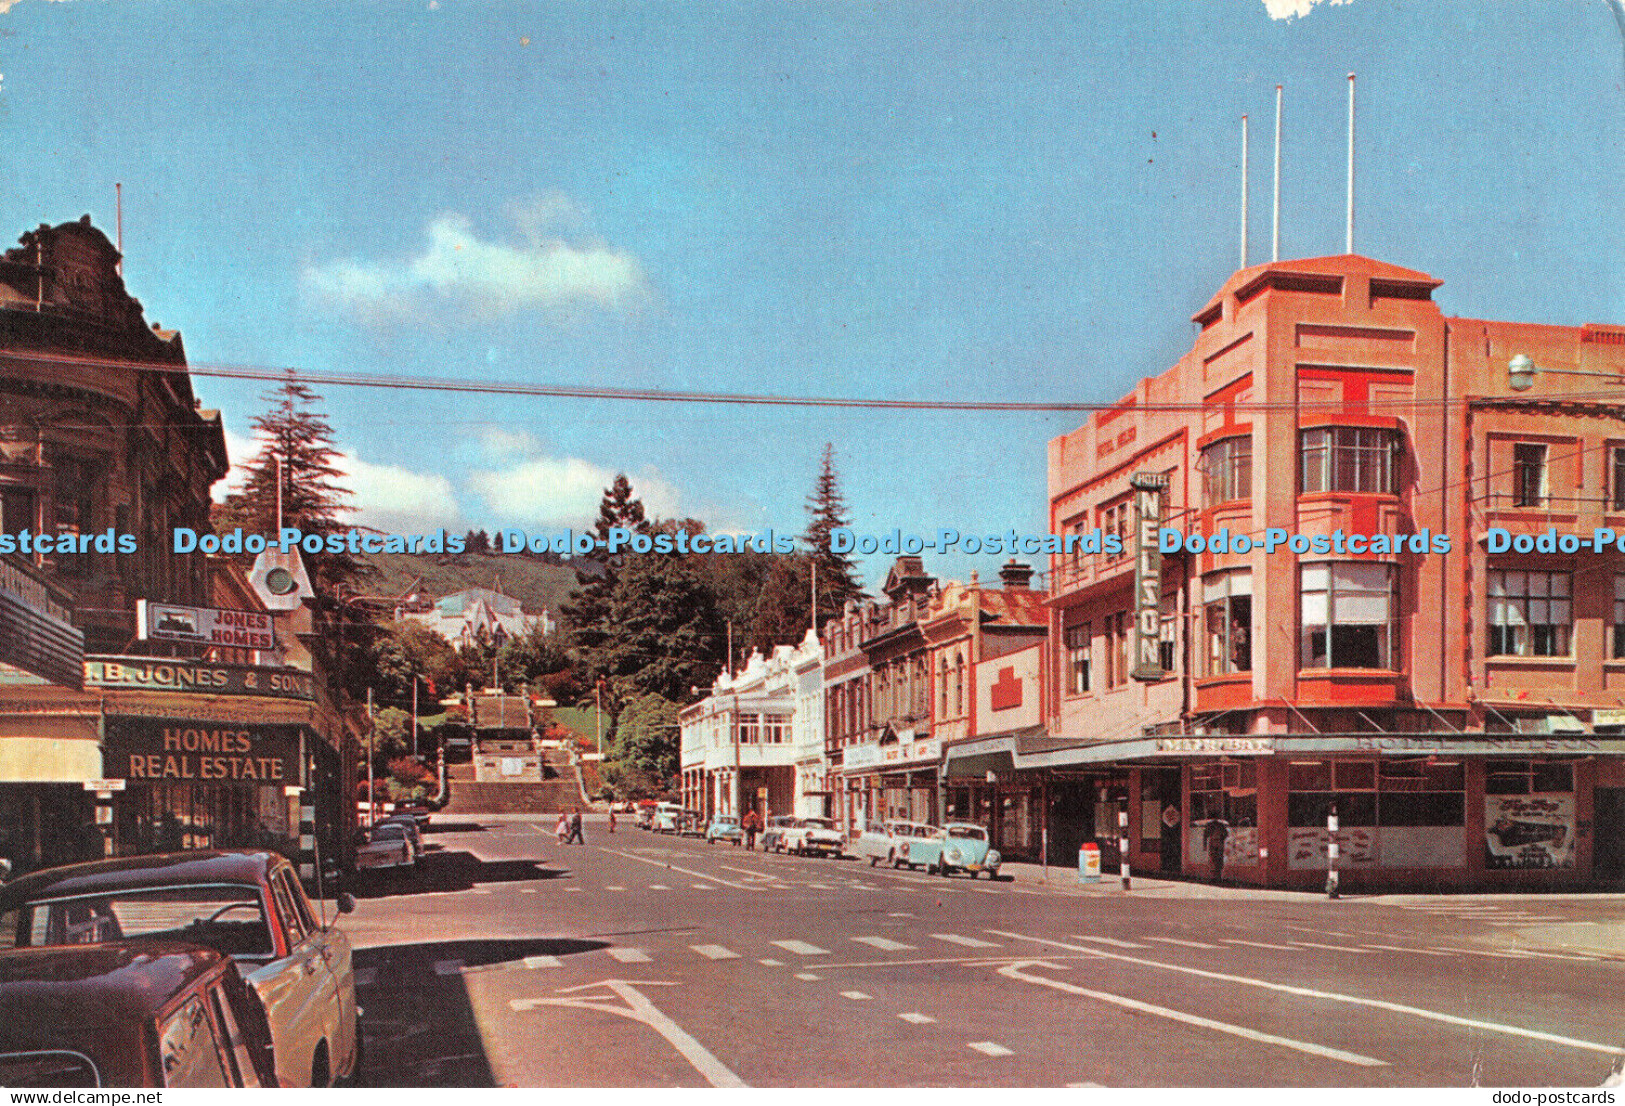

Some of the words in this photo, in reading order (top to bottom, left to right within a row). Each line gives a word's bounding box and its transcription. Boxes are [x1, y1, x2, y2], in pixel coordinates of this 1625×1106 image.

[1138, 472, 1170, 486] HOTEL
[1140, 490, 1160, 665] NELSON
[213, 610, 270, 629] JONES
[211, 628, 272, 648] HOMES
[137, 665, 230, 687] JONES
[245, 672, 258, 689] &
[164, 728, 251, 752] HOMES
[1356, 737, 1450, 750] HOTEL
[1488, 738, 1600, 750] NELSON
[129, 755, 195, 779] REAL
[200, 756, 284, 780] ESTATE
